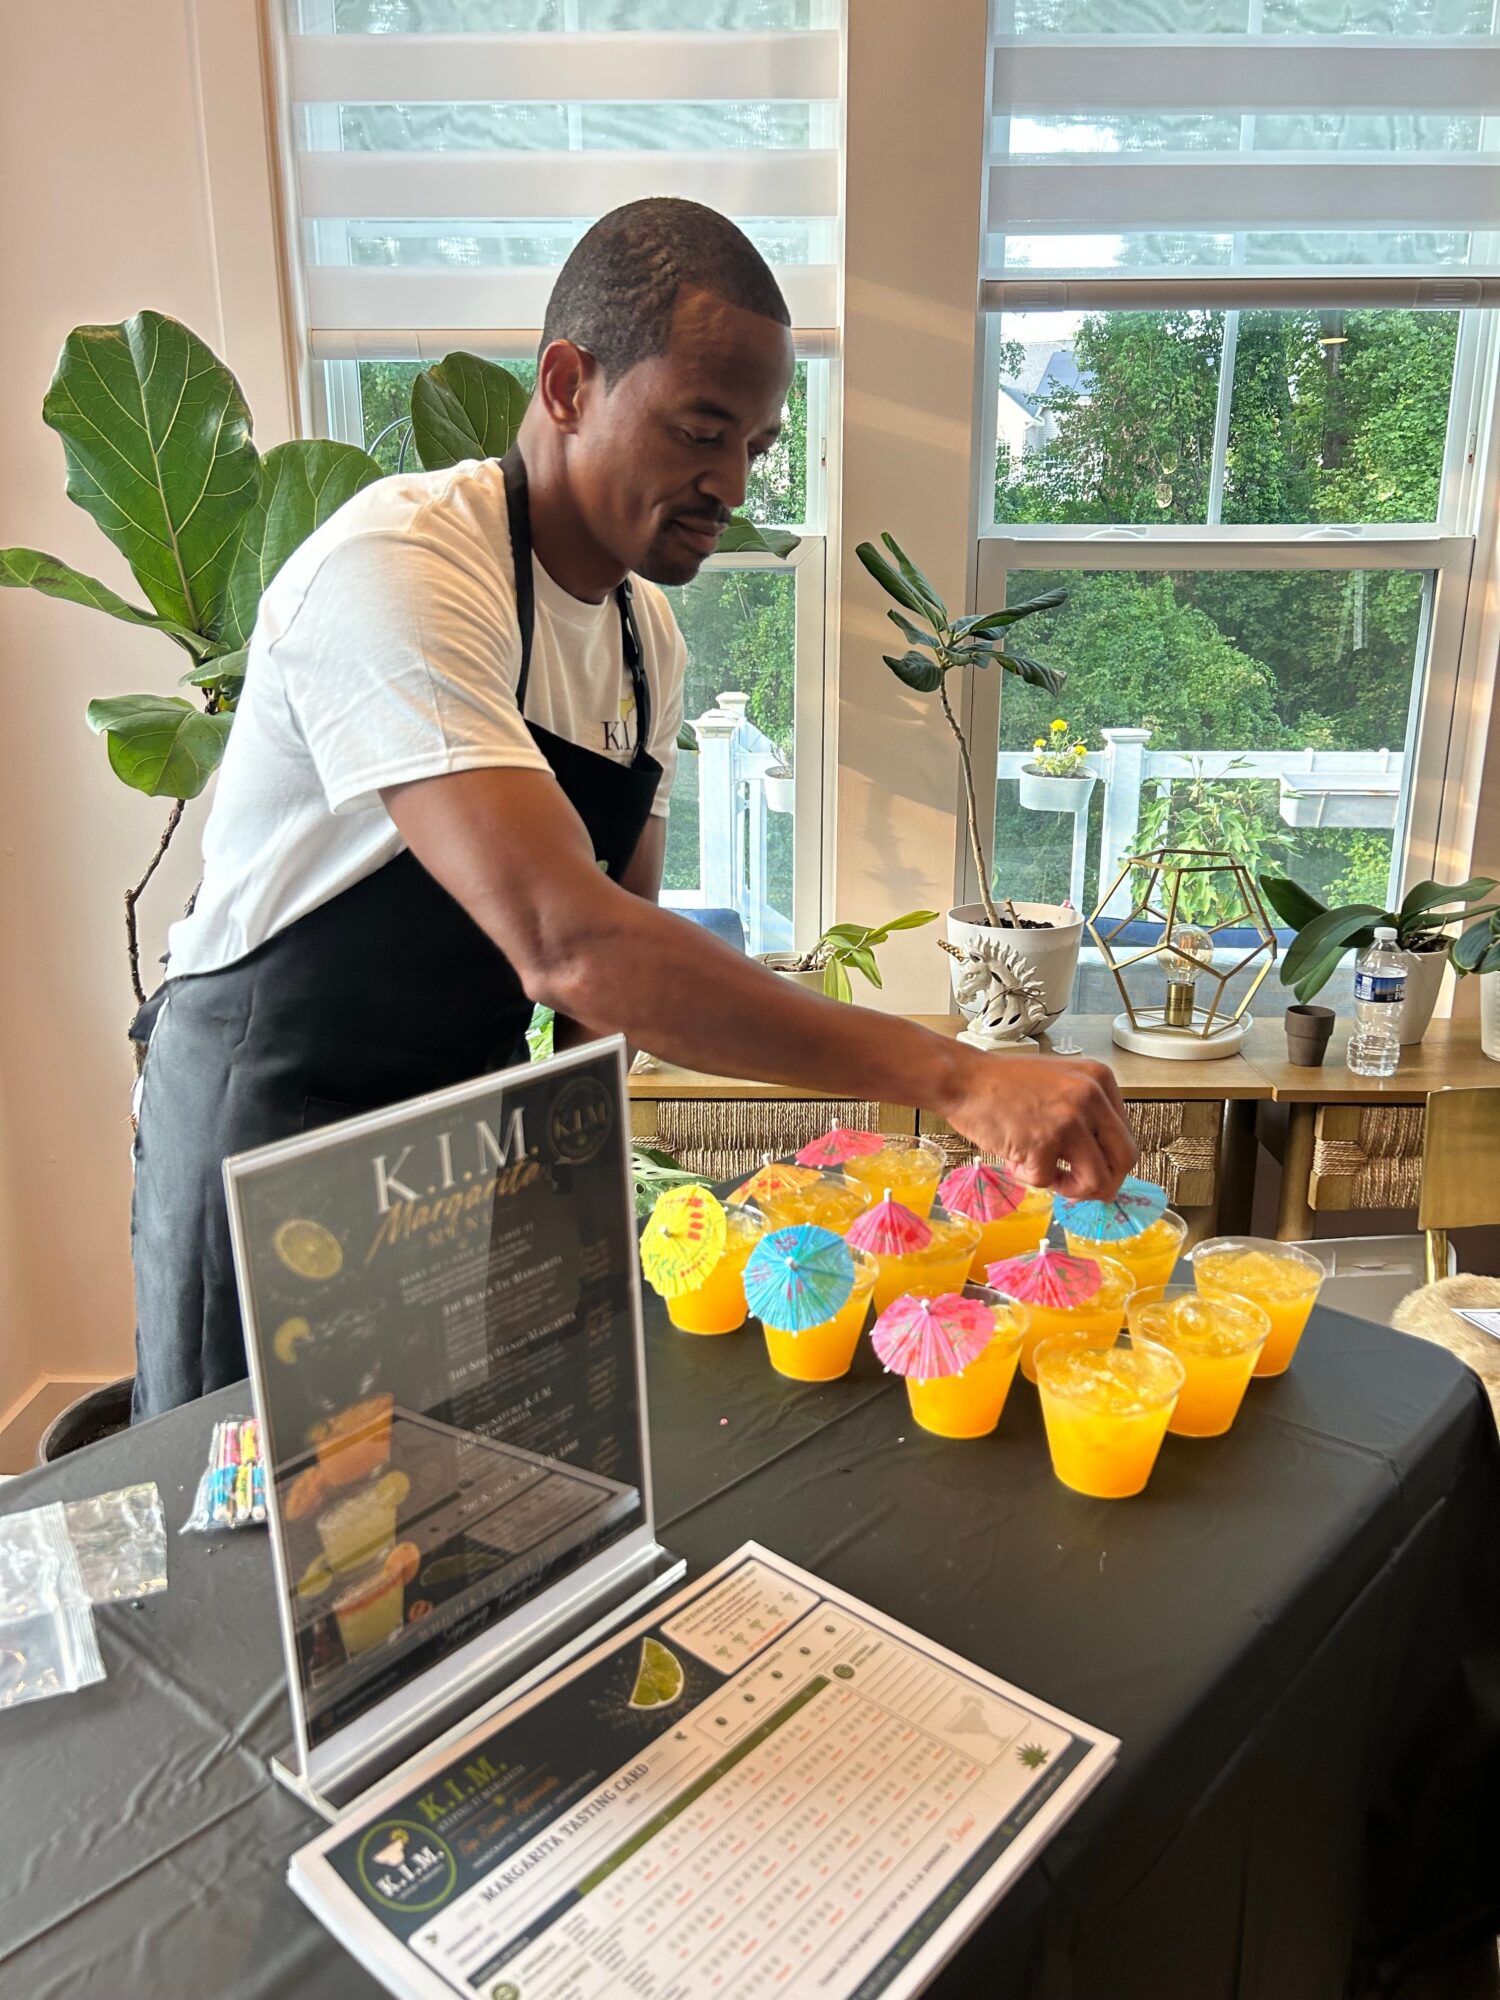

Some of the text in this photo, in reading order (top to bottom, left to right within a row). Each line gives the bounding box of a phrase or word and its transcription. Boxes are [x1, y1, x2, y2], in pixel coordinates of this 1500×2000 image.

[601, 720, 640, 751] KI
[371, 1106, 541, 1214] K.I.M.
[364, 1160, 543, 1267] Margarita
[417, 1756, 508, 1822] K.I.M.
[375, 1845, 445, 1897] K.I.M.
[480, 1835, 564, 1903] MARGARITA
[559, 1788, 618, 1837] TASTING
[614, 1762, 650, 1793] CARD
